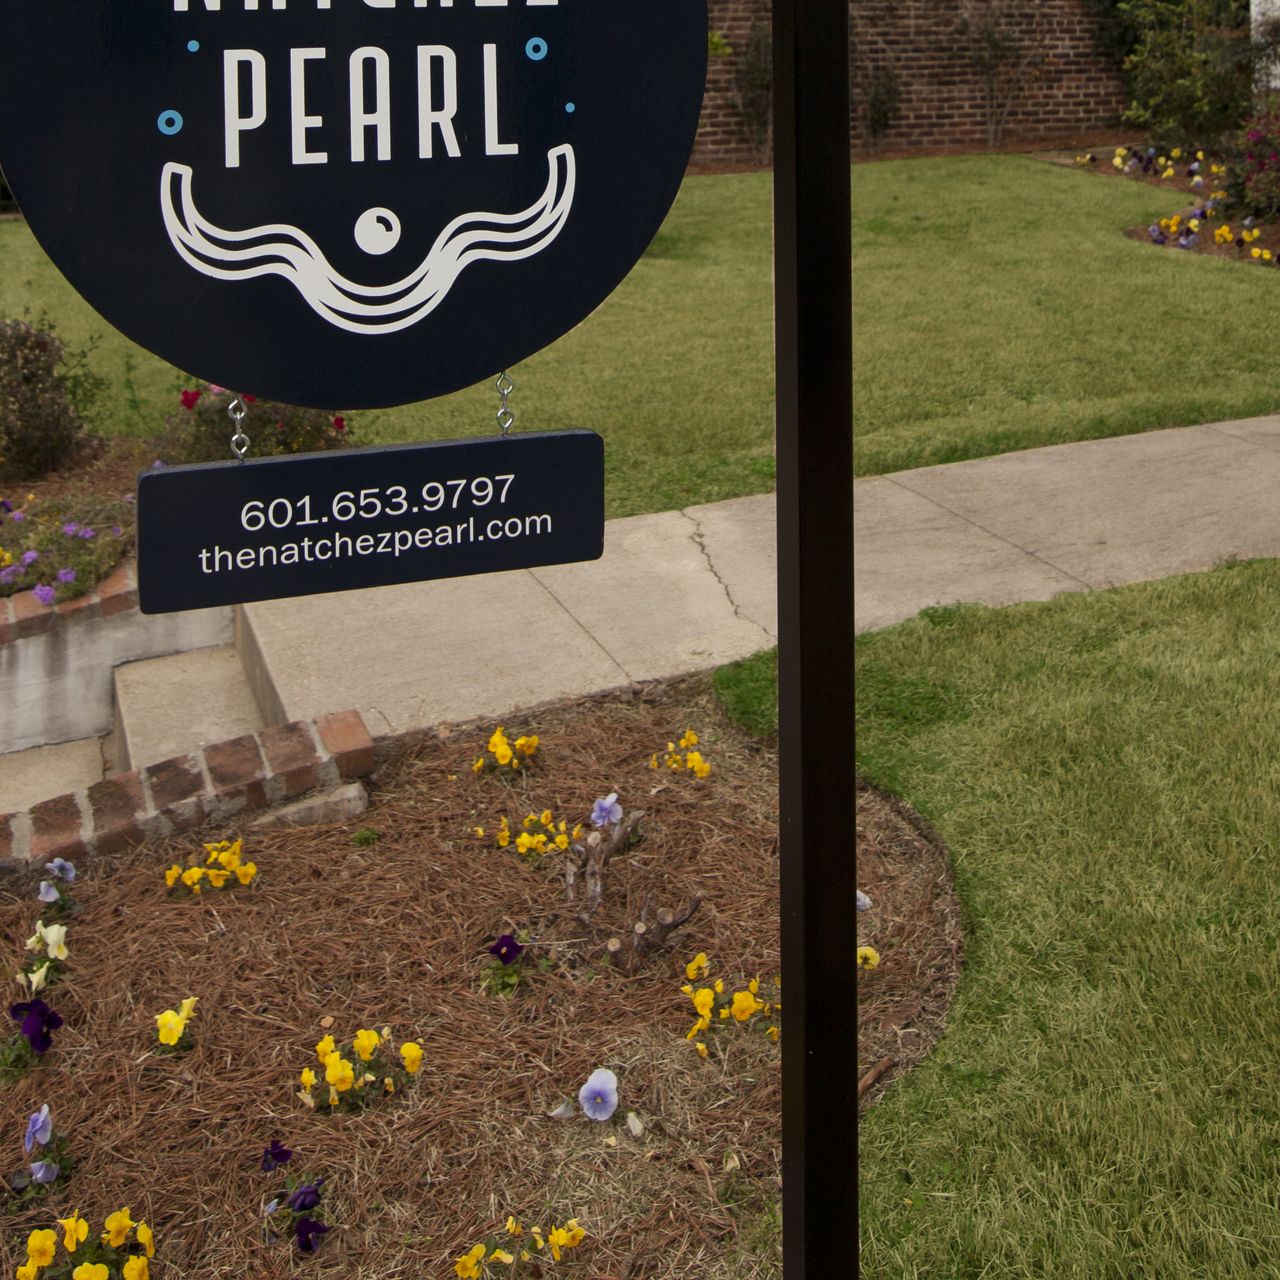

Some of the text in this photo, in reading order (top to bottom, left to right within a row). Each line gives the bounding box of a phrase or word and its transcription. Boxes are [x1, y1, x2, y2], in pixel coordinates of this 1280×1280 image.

[223, 43, 519, 168] PEARL
[240, 473, 515, 531] 601.653.9797
[198, 514, 552, 574] thenatchezpearl.com
